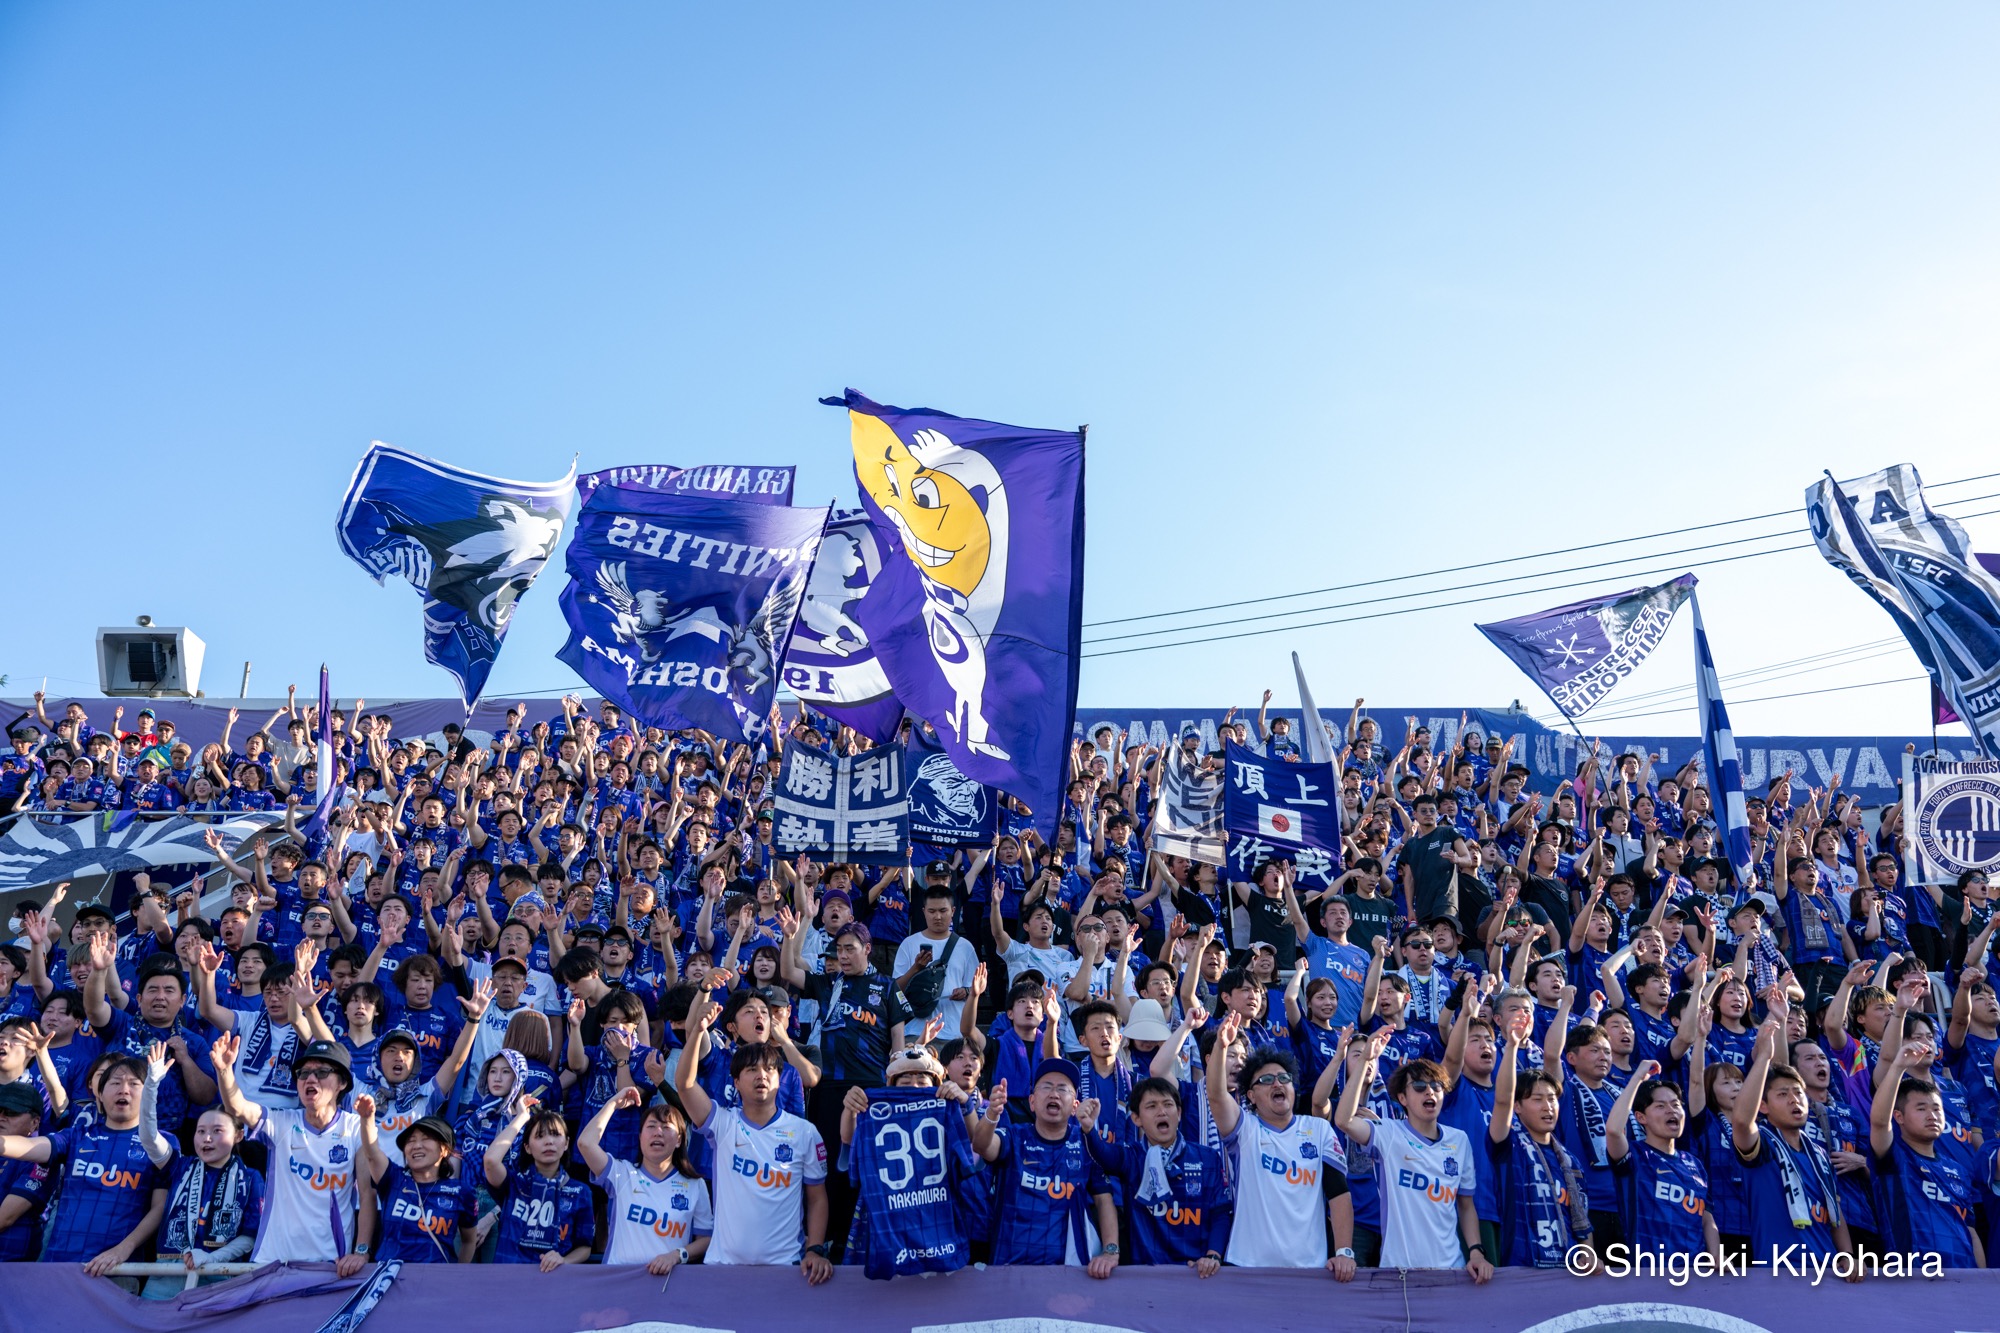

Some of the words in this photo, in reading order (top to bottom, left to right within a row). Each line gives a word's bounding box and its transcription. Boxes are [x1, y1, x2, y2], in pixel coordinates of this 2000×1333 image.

[1552, 605, 1652, 702] SANFRECCE
[1564, 609, 1671, 717] HIROSHIMA
[786, 750, 899, 802] 勝利
[1961, 760, 2000, 774] HIROS
[1232, 760, 1329, 807] 頂上
[1929, 790, 1949, 808] FORZA
[1948, 780, 1984, 795] SANFRECCE
[778, 815, 901, 853] 執着
[912, 823, 980, 839] INFINITIES
[931, 834, 958, 845] 1999
[1230, 835, 1334, 886] 作戦
[894, 1098, 947, 1114] mazda
[875, 1117, 948, 1190] 39
[527, 1198, 555, 1228] 20
[888, 1187, 948, 1210] NAKAMURA
[1536, 1219, 1564, 1248] 51
